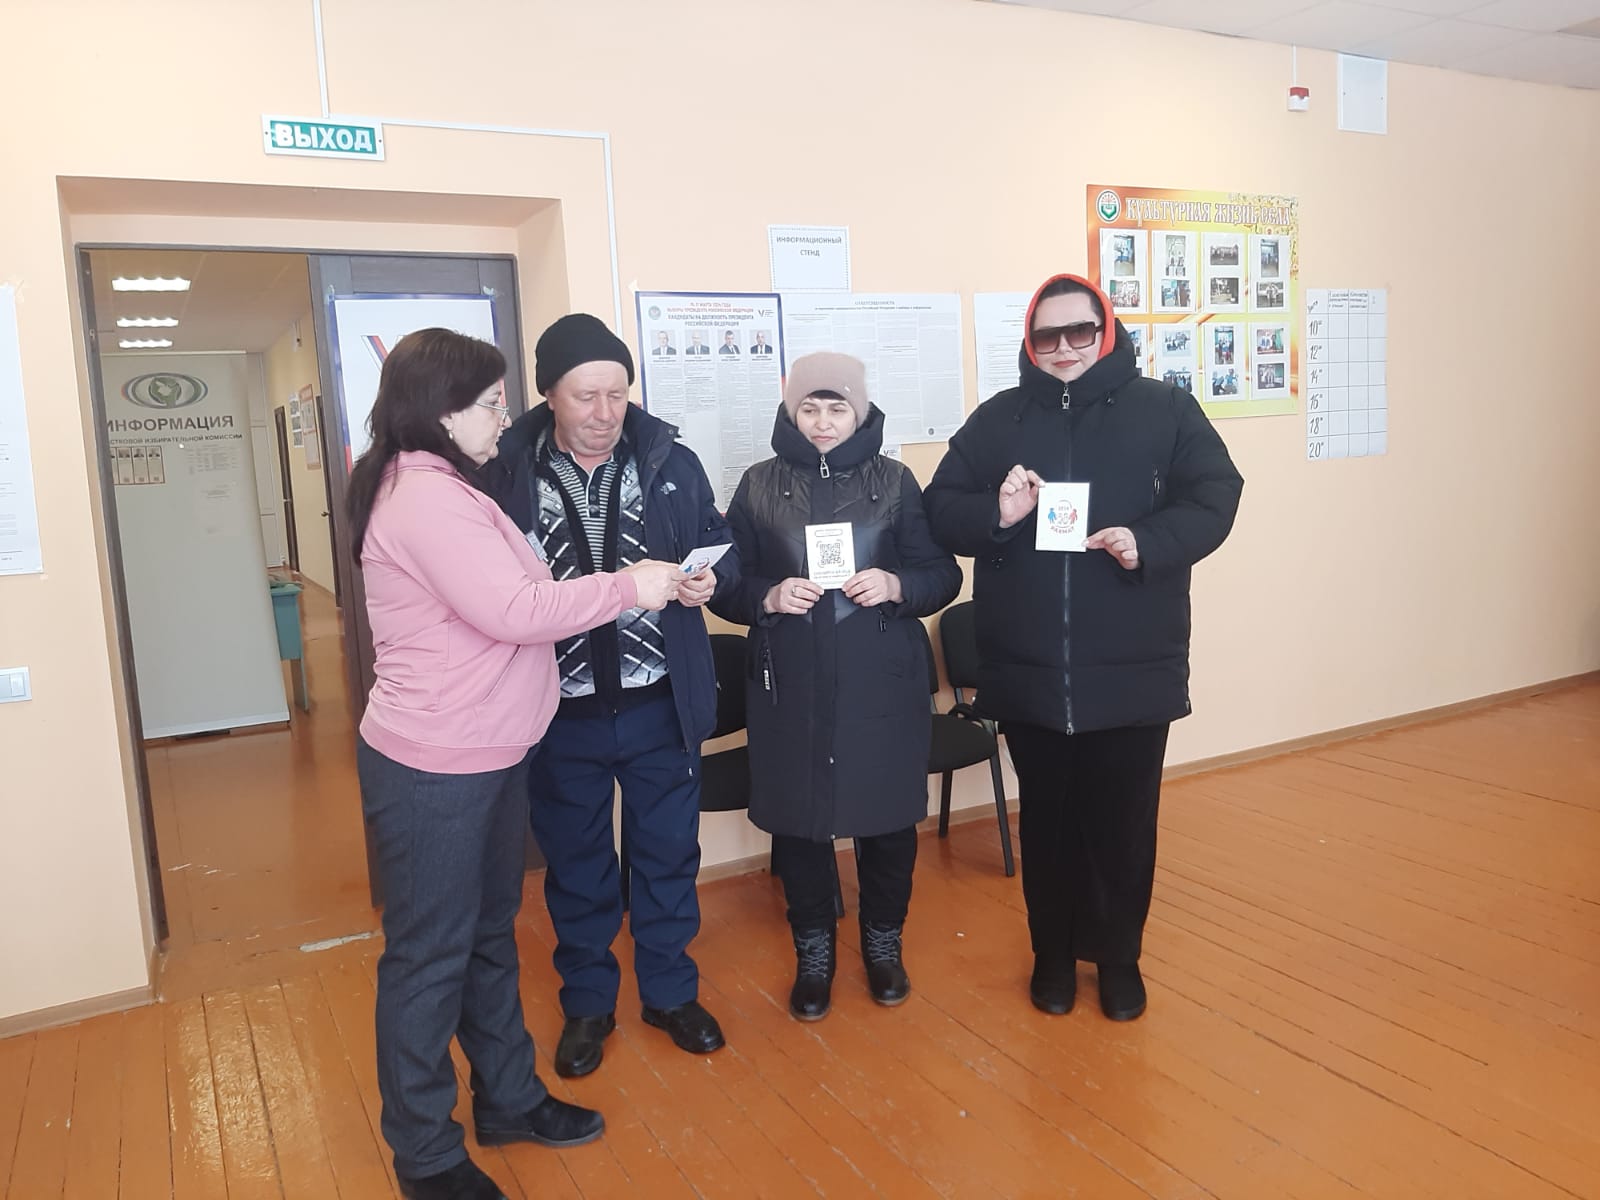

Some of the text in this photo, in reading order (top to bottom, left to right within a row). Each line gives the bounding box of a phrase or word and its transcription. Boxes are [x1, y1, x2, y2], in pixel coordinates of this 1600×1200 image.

[274, 123, 373, 152] ВЫХОД
[1126, 198, 1291, 227] КУЛЬТУРНАЯ ЖИЗНЬ СЕЛА
[776, 236, 842, 244] ИНФОРМАЦИОННЫЙ
[800, 249, 820, 257] СТЕНД
[107, 415, 234, 432] ИНФОРМАЦИЯ
[205, 433, 243, 441] КОМИССИИ
